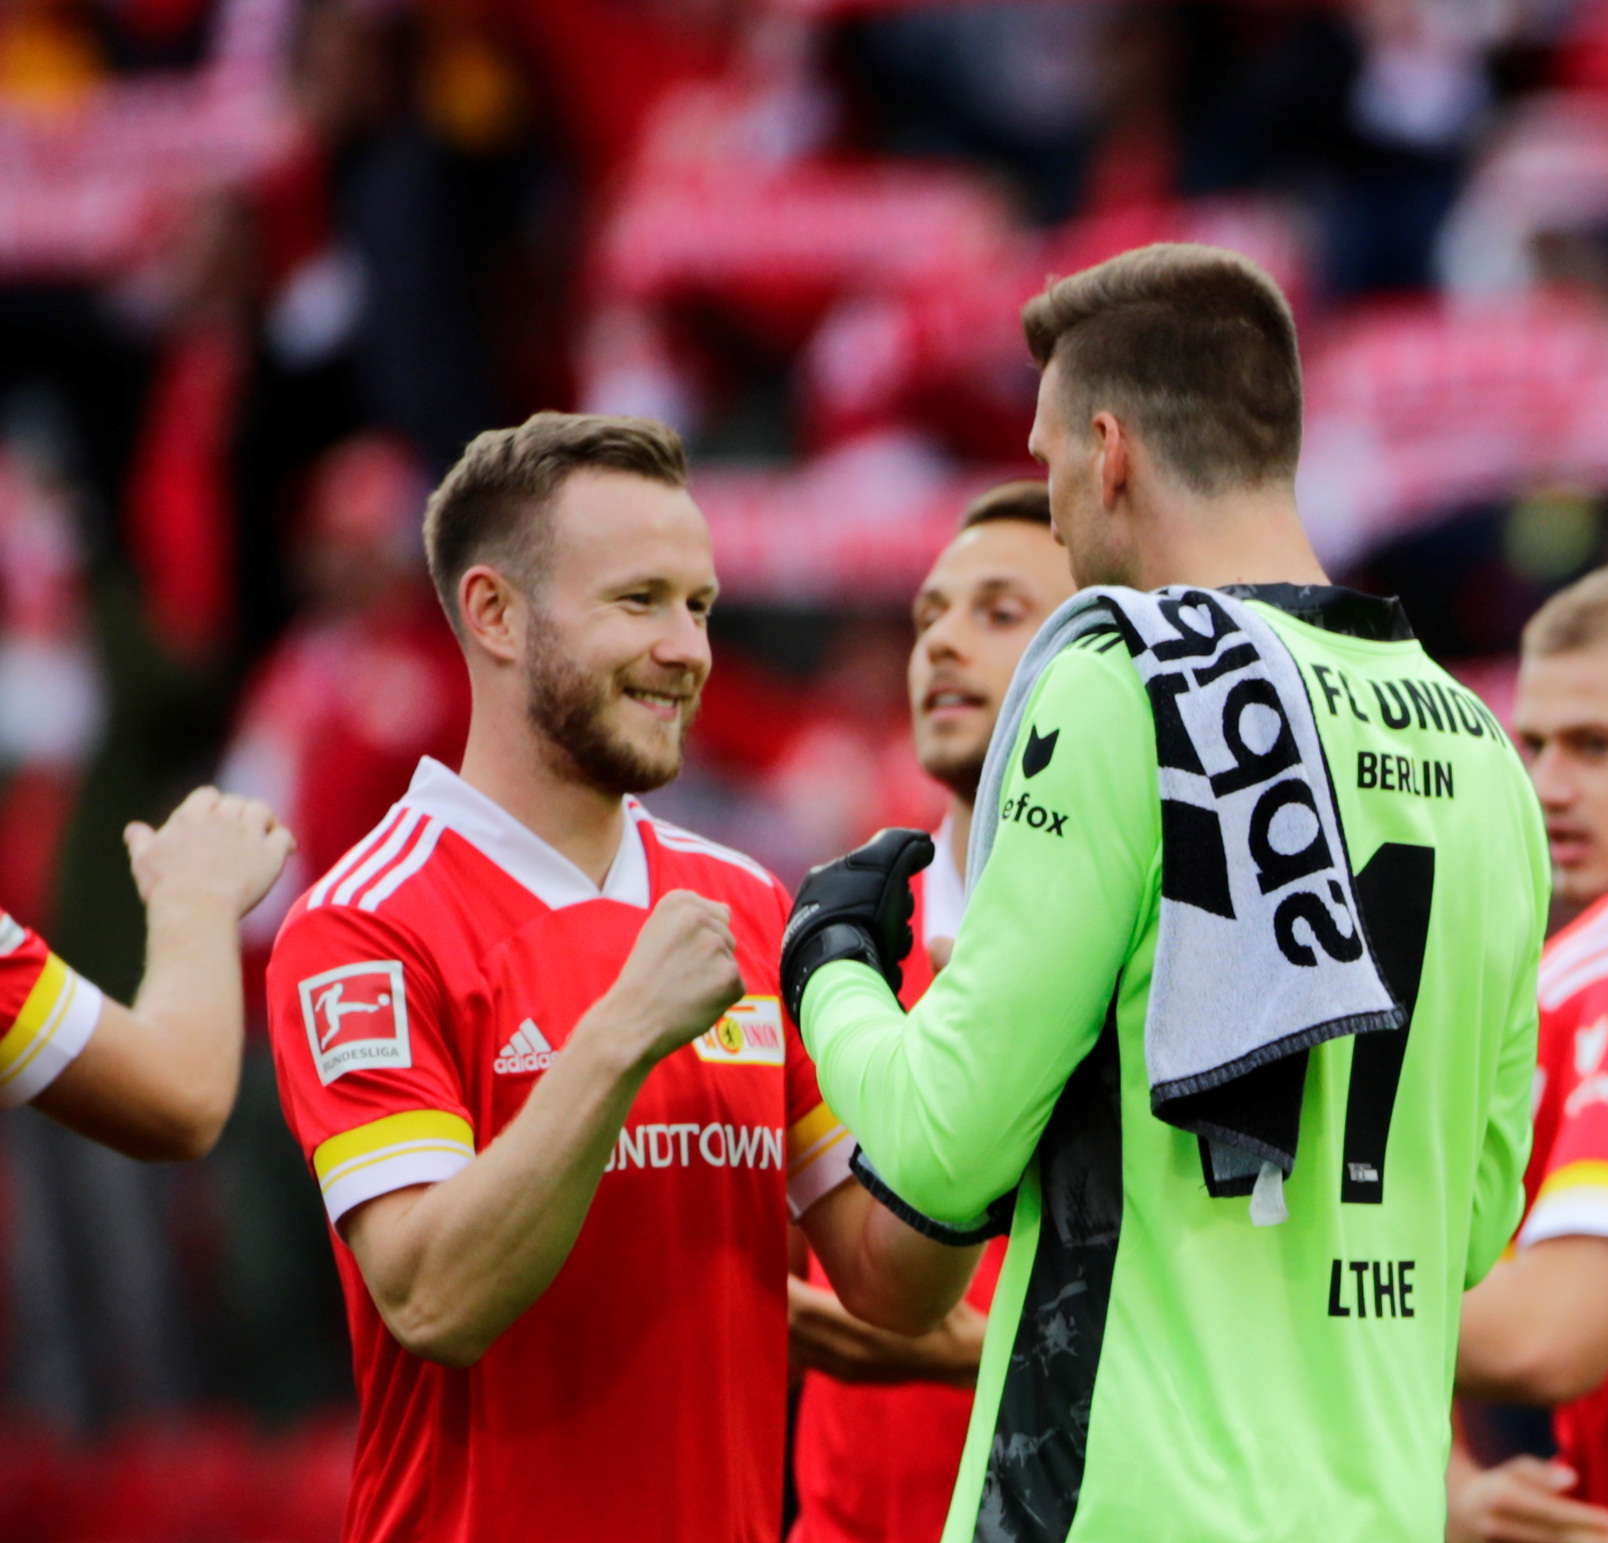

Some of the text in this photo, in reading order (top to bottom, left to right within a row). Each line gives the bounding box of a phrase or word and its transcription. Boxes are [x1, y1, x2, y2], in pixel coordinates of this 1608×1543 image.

[1357, 751, 1455, 799] BERLIN
[323, 1046, 400, 1074] BUNDESLIGA
[604, 1122, 784, 1172] NDTOWN
